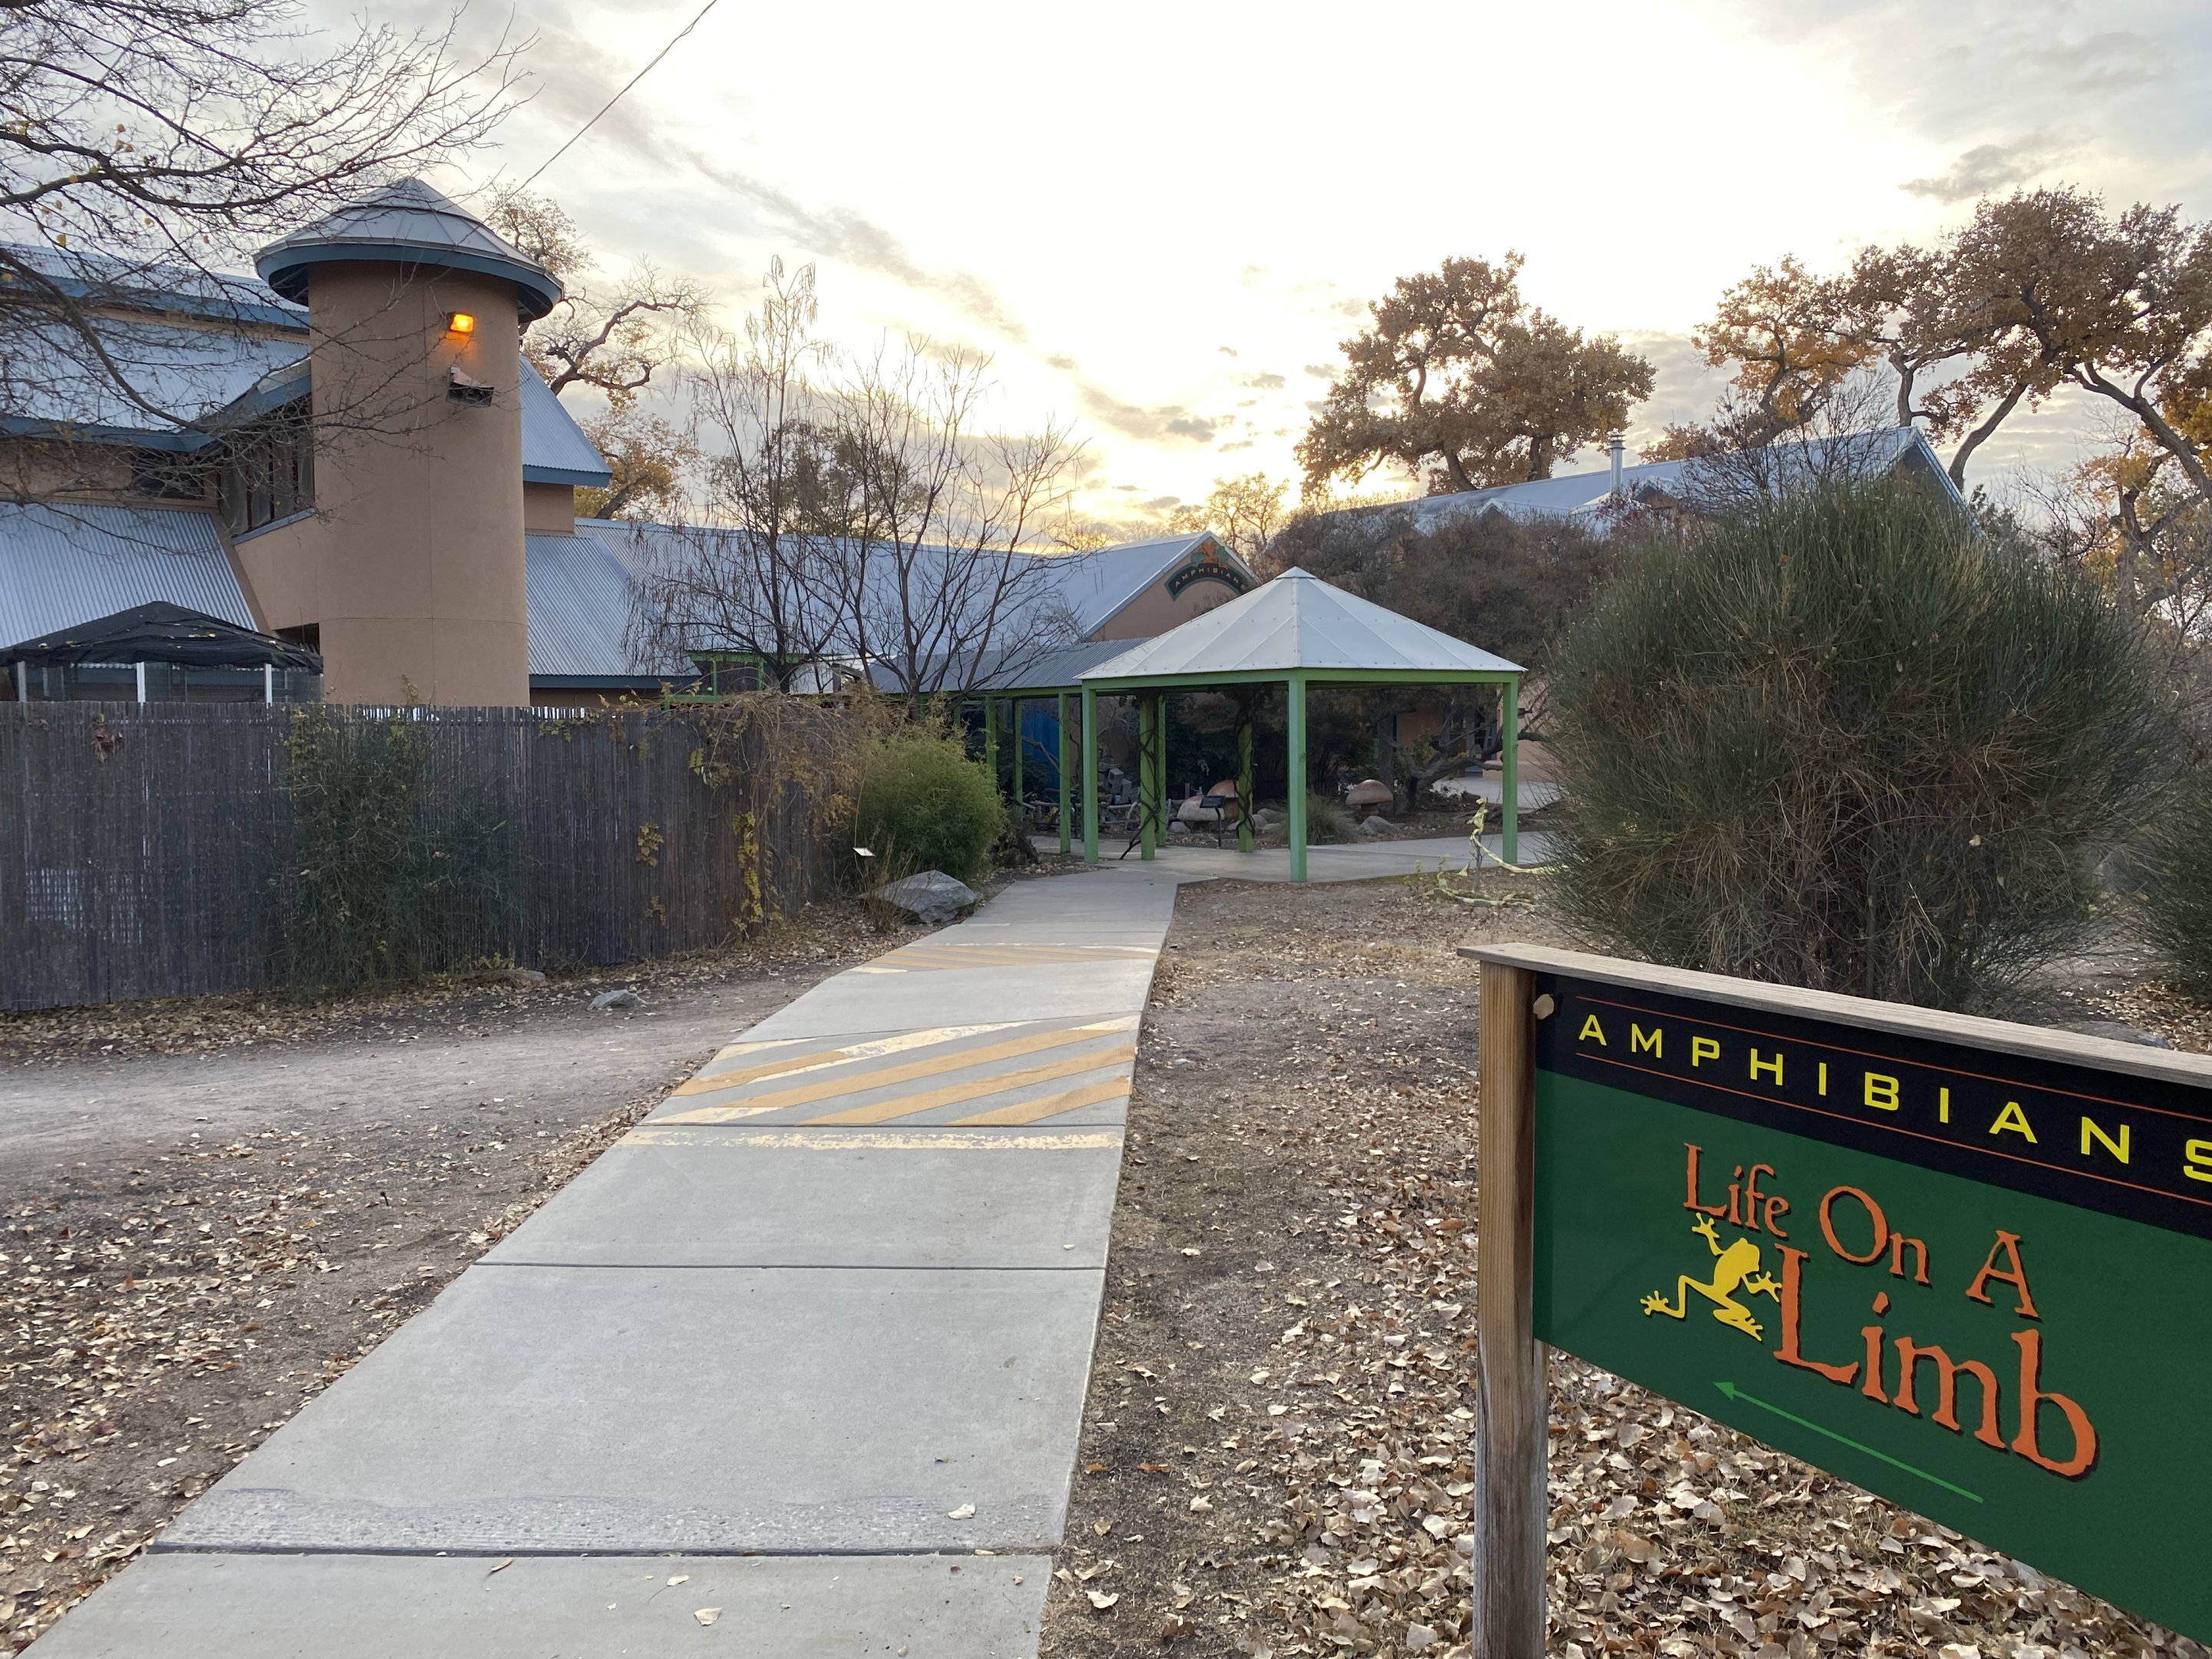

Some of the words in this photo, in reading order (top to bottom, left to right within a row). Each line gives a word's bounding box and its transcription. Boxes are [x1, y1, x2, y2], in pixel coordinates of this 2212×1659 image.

[1683, 1143, 1790, 1238] Life
[1818, 1185, 1931, 1284] On
[1965, 1230, 2040, 1319] A
[1773, 1243, 2098, 1479] Limb
